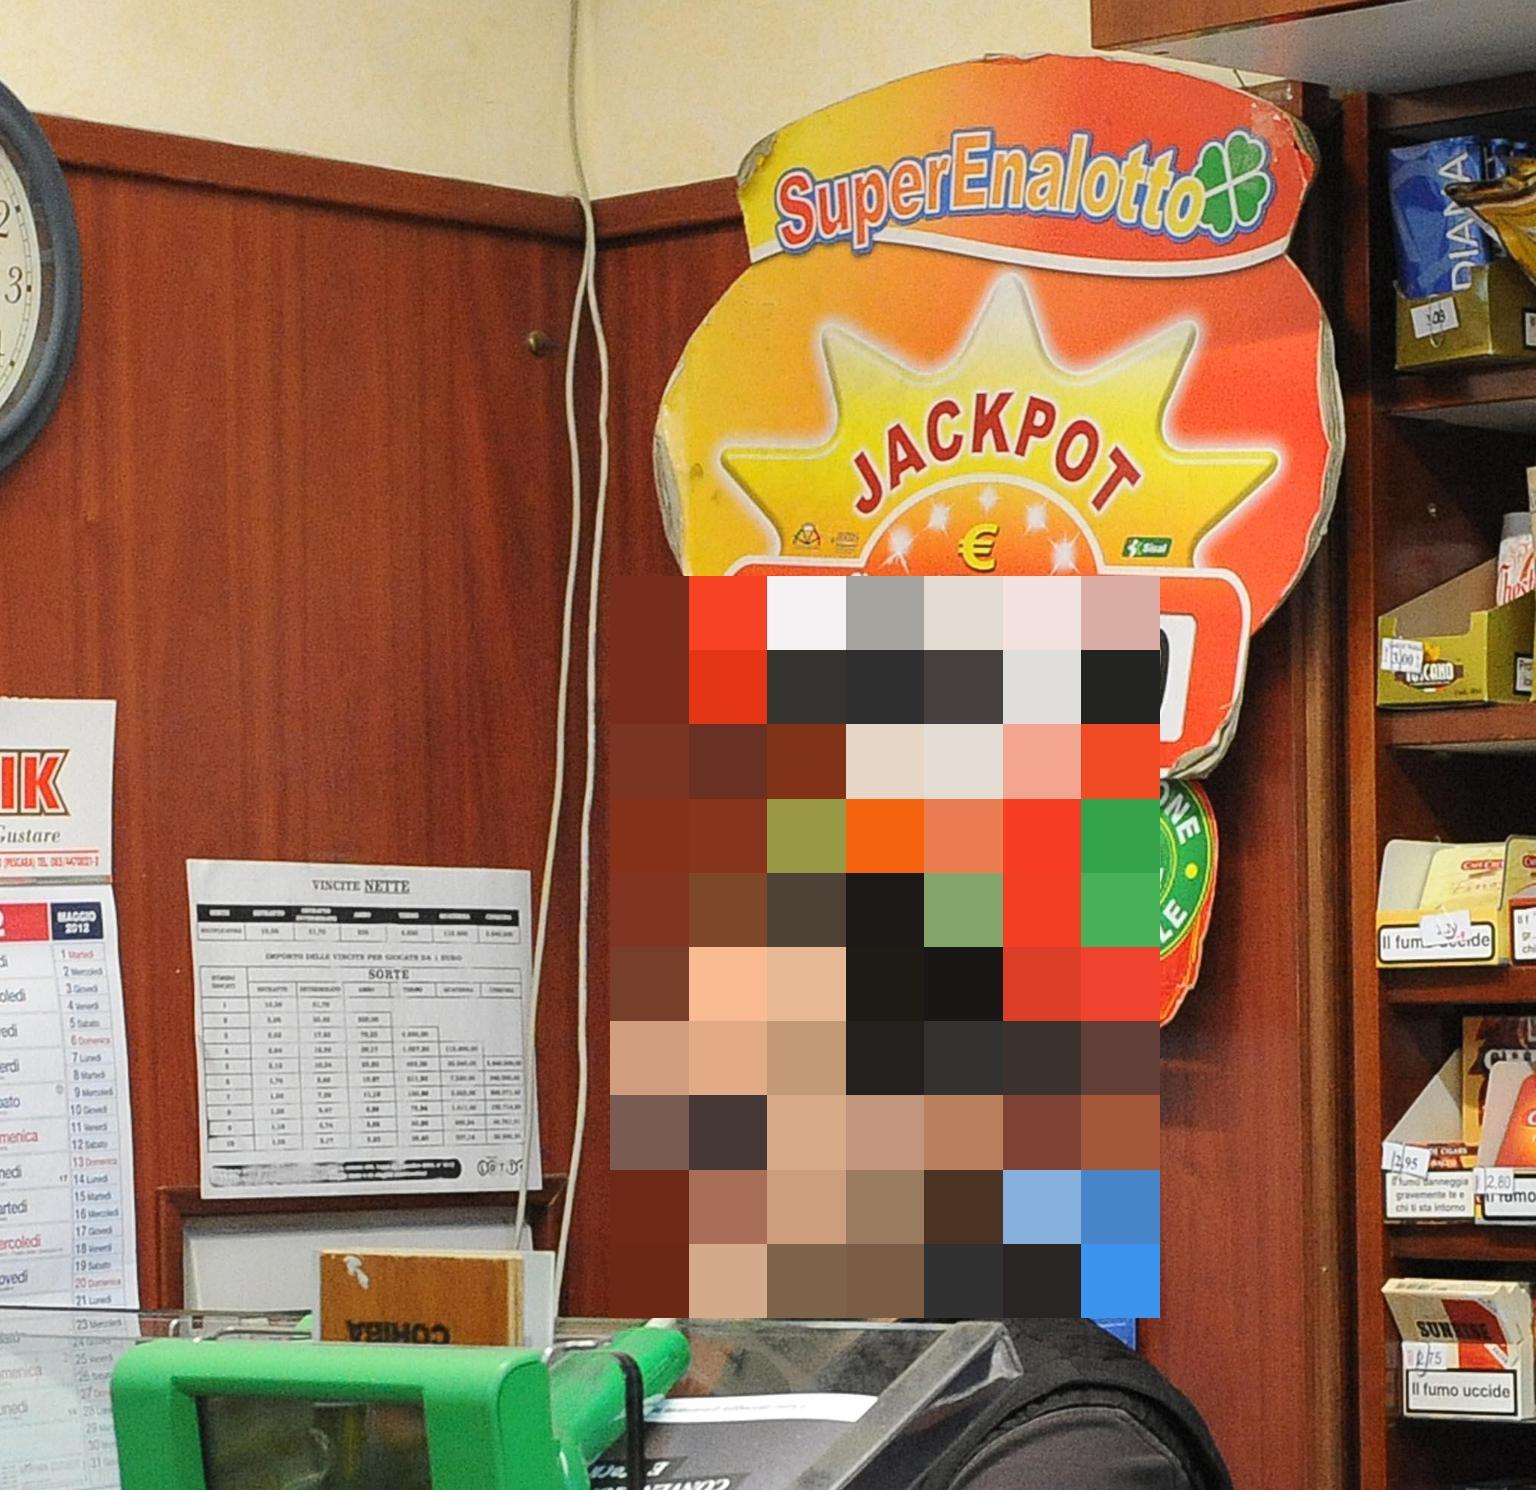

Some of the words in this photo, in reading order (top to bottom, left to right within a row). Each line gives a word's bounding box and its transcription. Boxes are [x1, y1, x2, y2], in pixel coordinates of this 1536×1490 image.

[775, 126, 1208, 255] SuperEnalotto
[4, 266, 23, 304] 3
[849, 391, 1142, 516] JACKPOT
[958, 523, 999, 570] €
[312, 879, 362, 892] VINCITE
[364, 880, 410, 894] NETTE
[56, 910, 97, 923] MAGGIO
[65, 922, 91, 935] 2012
[368, 969, 410, 980] SORTE
[1396, 1190, 1446, 1202] gravemente
[1434, 1203, 1466, 1213] intorno
[346, 1320, 450, 1344] COHIBA
[1411, 1382, 1420, 1396] Il
[1423, 1382, 1459, 1397] fumo
[1463, 1383, 1511, 1398] uccide
